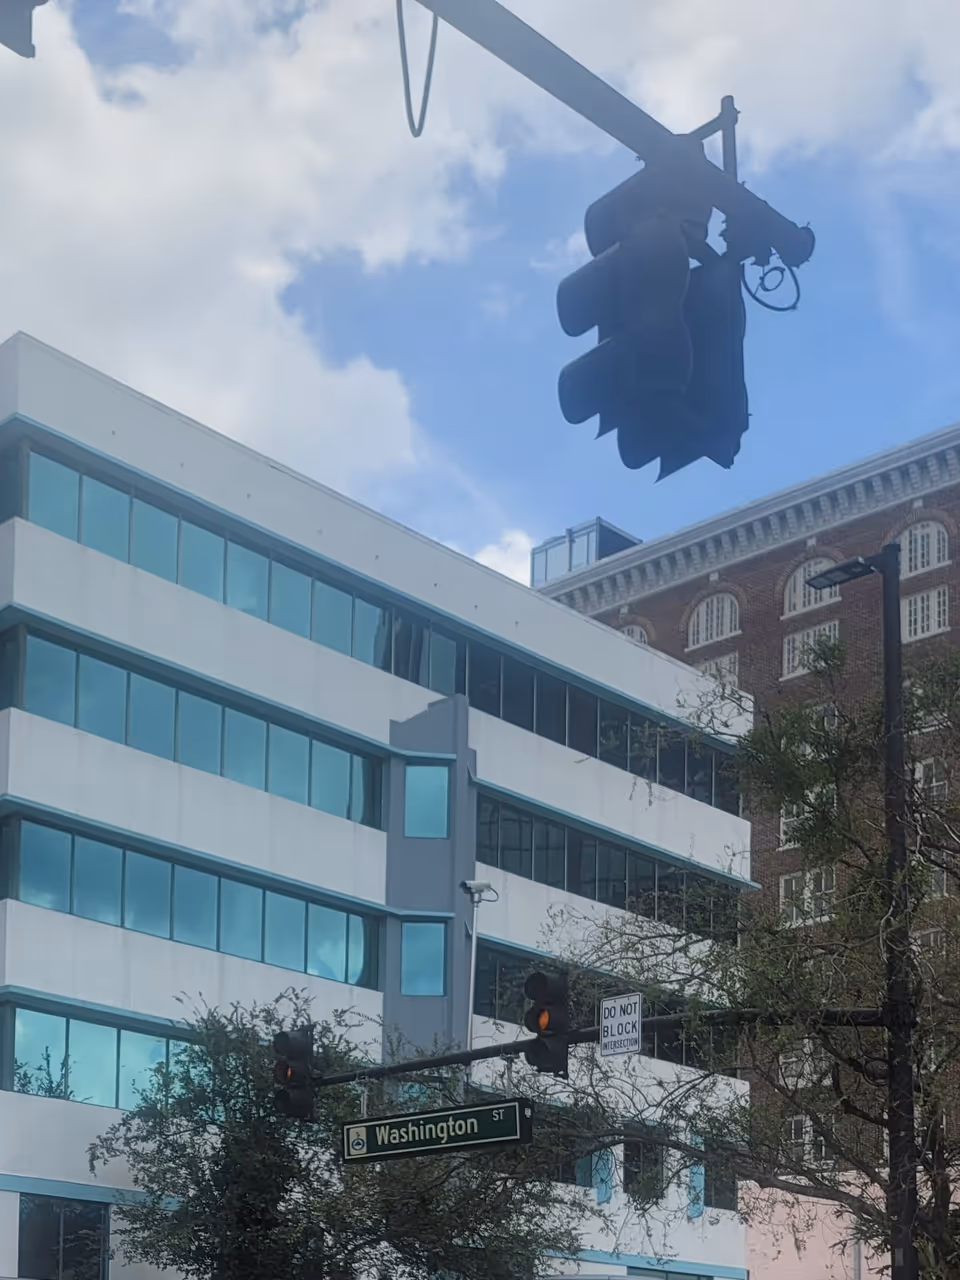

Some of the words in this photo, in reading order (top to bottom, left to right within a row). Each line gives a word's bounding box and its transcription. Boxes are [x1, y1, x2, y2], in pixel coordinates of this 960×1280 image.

[604, 1006, 616, 1019] DO
[620, 1002, 637, 1016] NOT
[603, 1020, 637, 1037] BLOCK
[603, 1037, 637, 1050] INTERSECTION
[376, 1116, 478, 1146] Washington
[492, 1109, 505, 1121] ST
